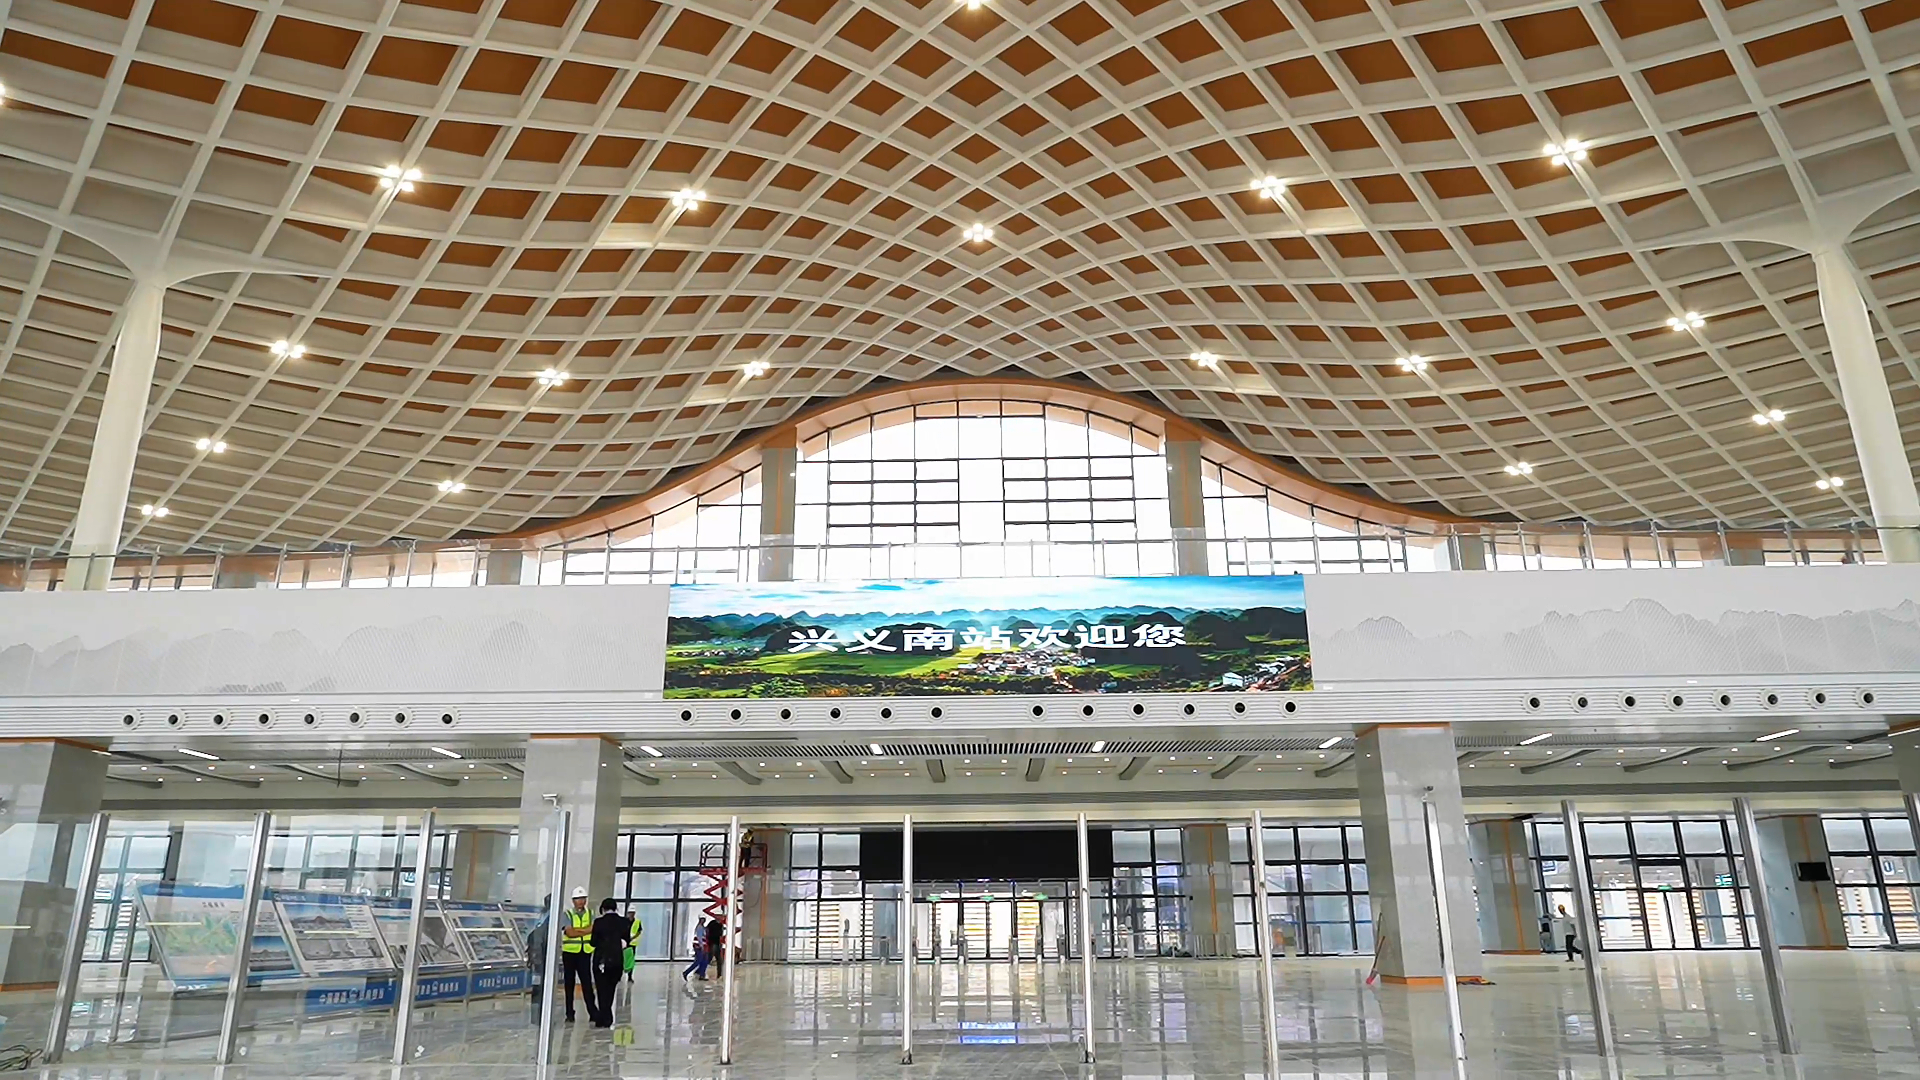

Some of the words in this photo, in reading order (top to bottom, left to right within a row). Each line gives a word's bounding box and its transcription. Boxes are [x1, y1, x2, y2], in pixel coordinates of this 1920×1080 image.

[788, 623, 1187, 653] 兴义南站欢迎您
